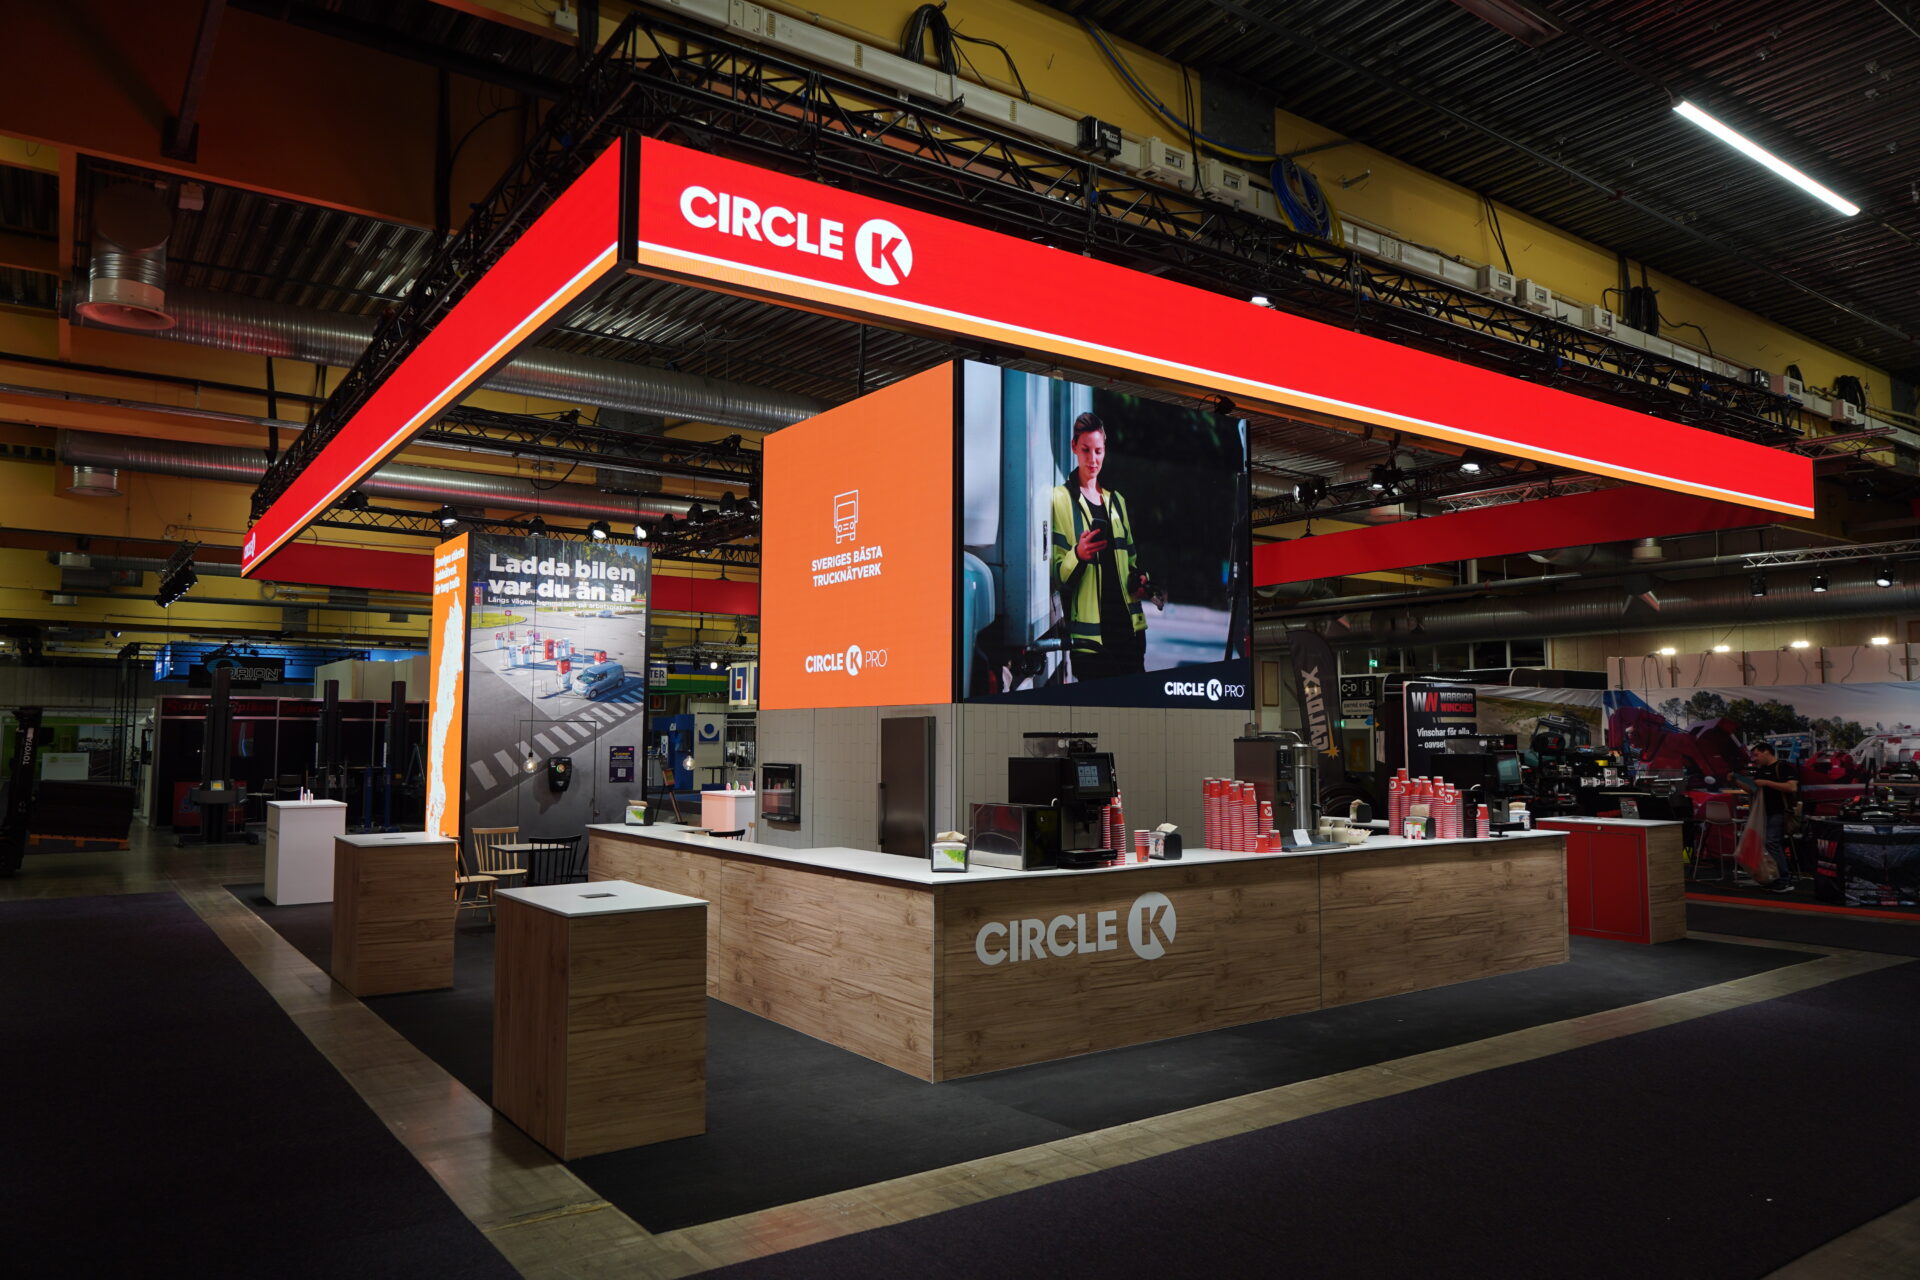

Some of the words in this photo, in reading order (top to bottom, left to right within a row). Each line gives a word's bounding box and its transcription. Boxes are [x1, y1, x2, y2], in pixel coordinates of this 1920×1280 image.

[680, 186, 844, 261] CIRCLE
[862, 224, 911, 286] K
[490, 553, 570, 577] Ladda
[575, 559, 636, 582] bilen
[811, 552, 852, 572] SVERIGES
[853, 545, 883, 563] BÄSTA
[812, 563, 882, 587] TRUCKNÄTVERK
[488, 579, 531, 596] var
[537, 579, 570, 598] du
[576, 581, 606, 601] än
[611, 583, 636, 603] är
[488, 596, 510, 604] Längs
[805, 653, 844, 673] CIRCLE
[848, 648, 862, 676] K
[865, 649, 887, 668] PRO
[1164, 682, 1205, 696] CIRCLE
[1208, 681, 1222, 700] K
[1224, 684, 1244, 698] PRO
[1341, 684, 1357, 692] C-D
[1440, 692, 1474, 701] WARRIOR
[1416, 727, 1446, 737] Vinschar
[1447, 727, 1457, 736] för
[22, 737, 33, 766] TOYOTA
[976, 910, 1118, 966] CIRCLE
[1134, 897, 1175, 958] K
